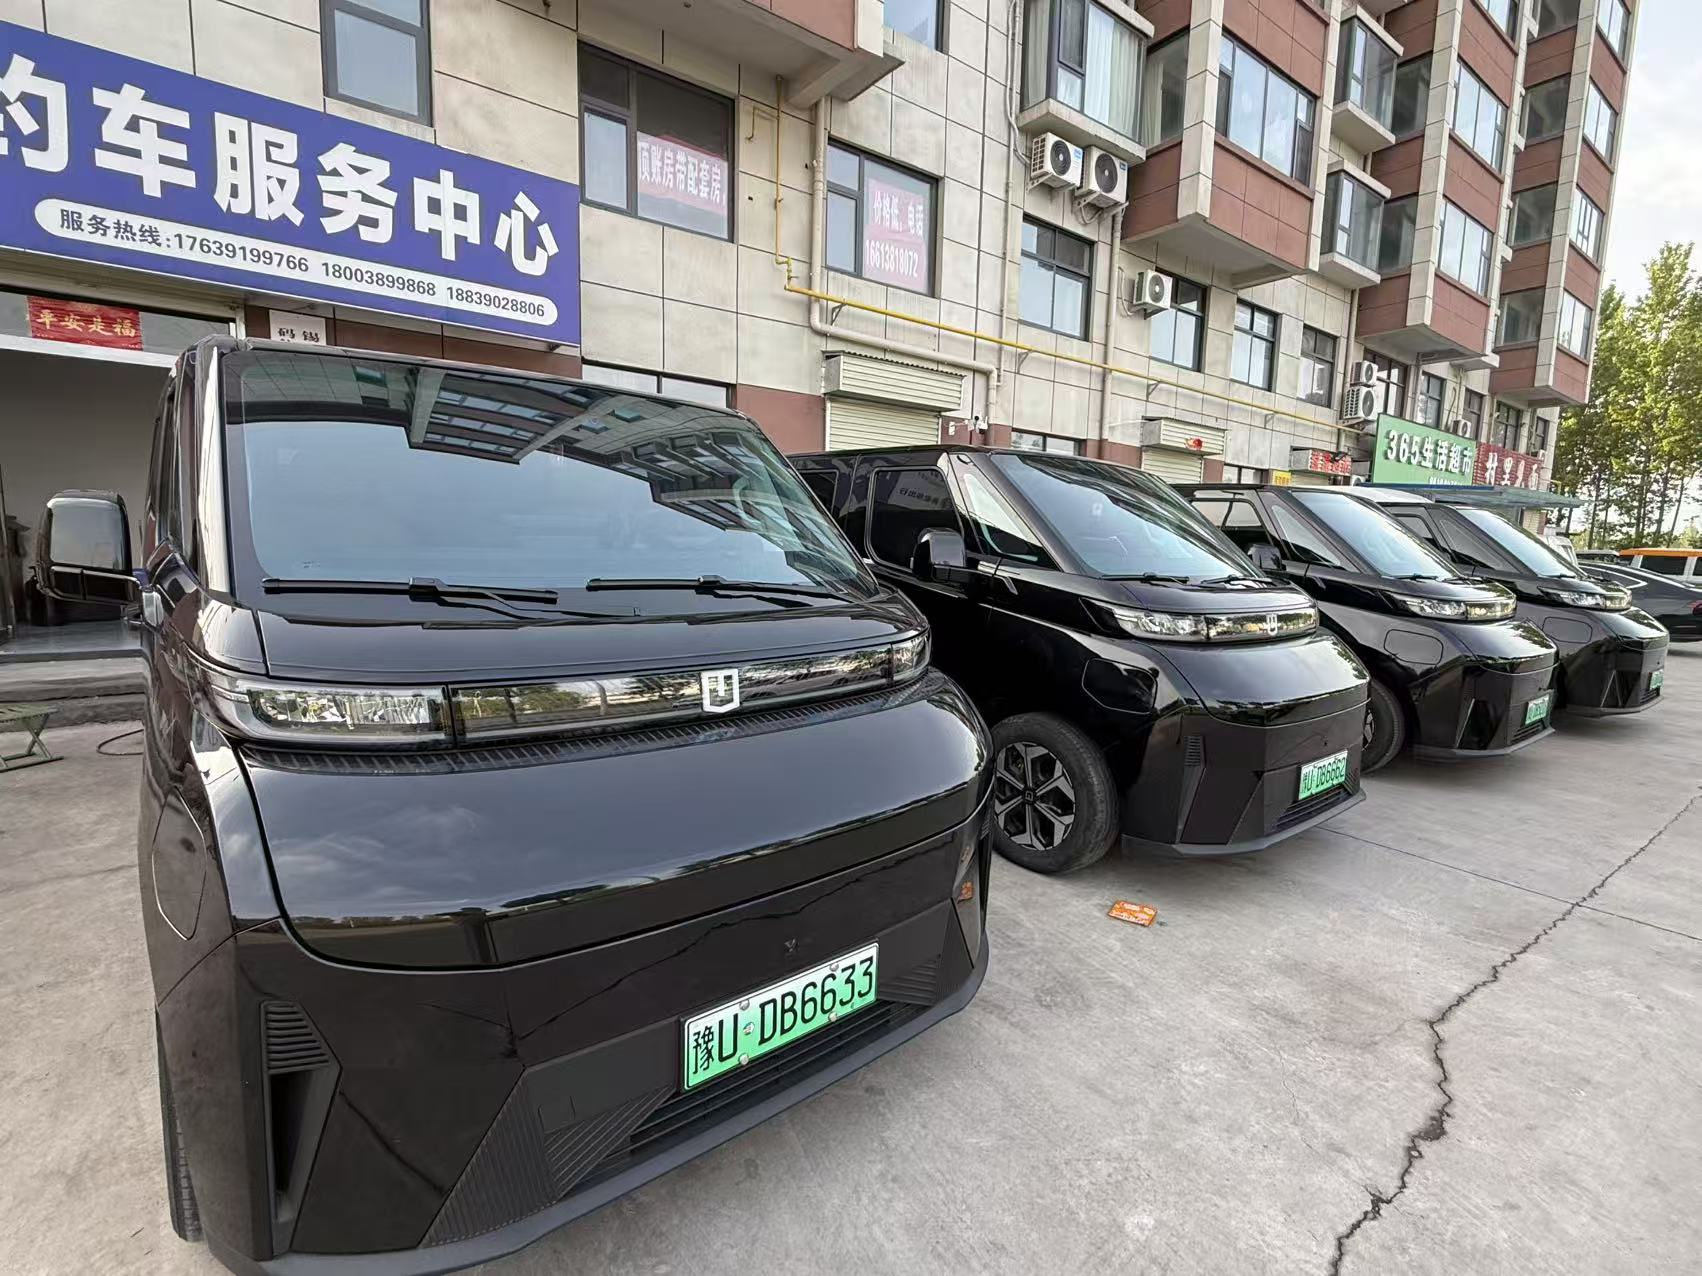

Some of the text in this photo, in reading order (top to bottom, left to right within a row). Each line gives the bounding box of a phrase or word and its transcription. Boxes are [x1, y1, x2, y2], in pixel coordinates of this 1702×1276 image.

[865, 240, 919, 278] 16613818072
[321, 262, 436, 297] 18003899868
[446, 286, 545, 317] 18839028806
[1386, 429, 1473, 475] 365生活超市
